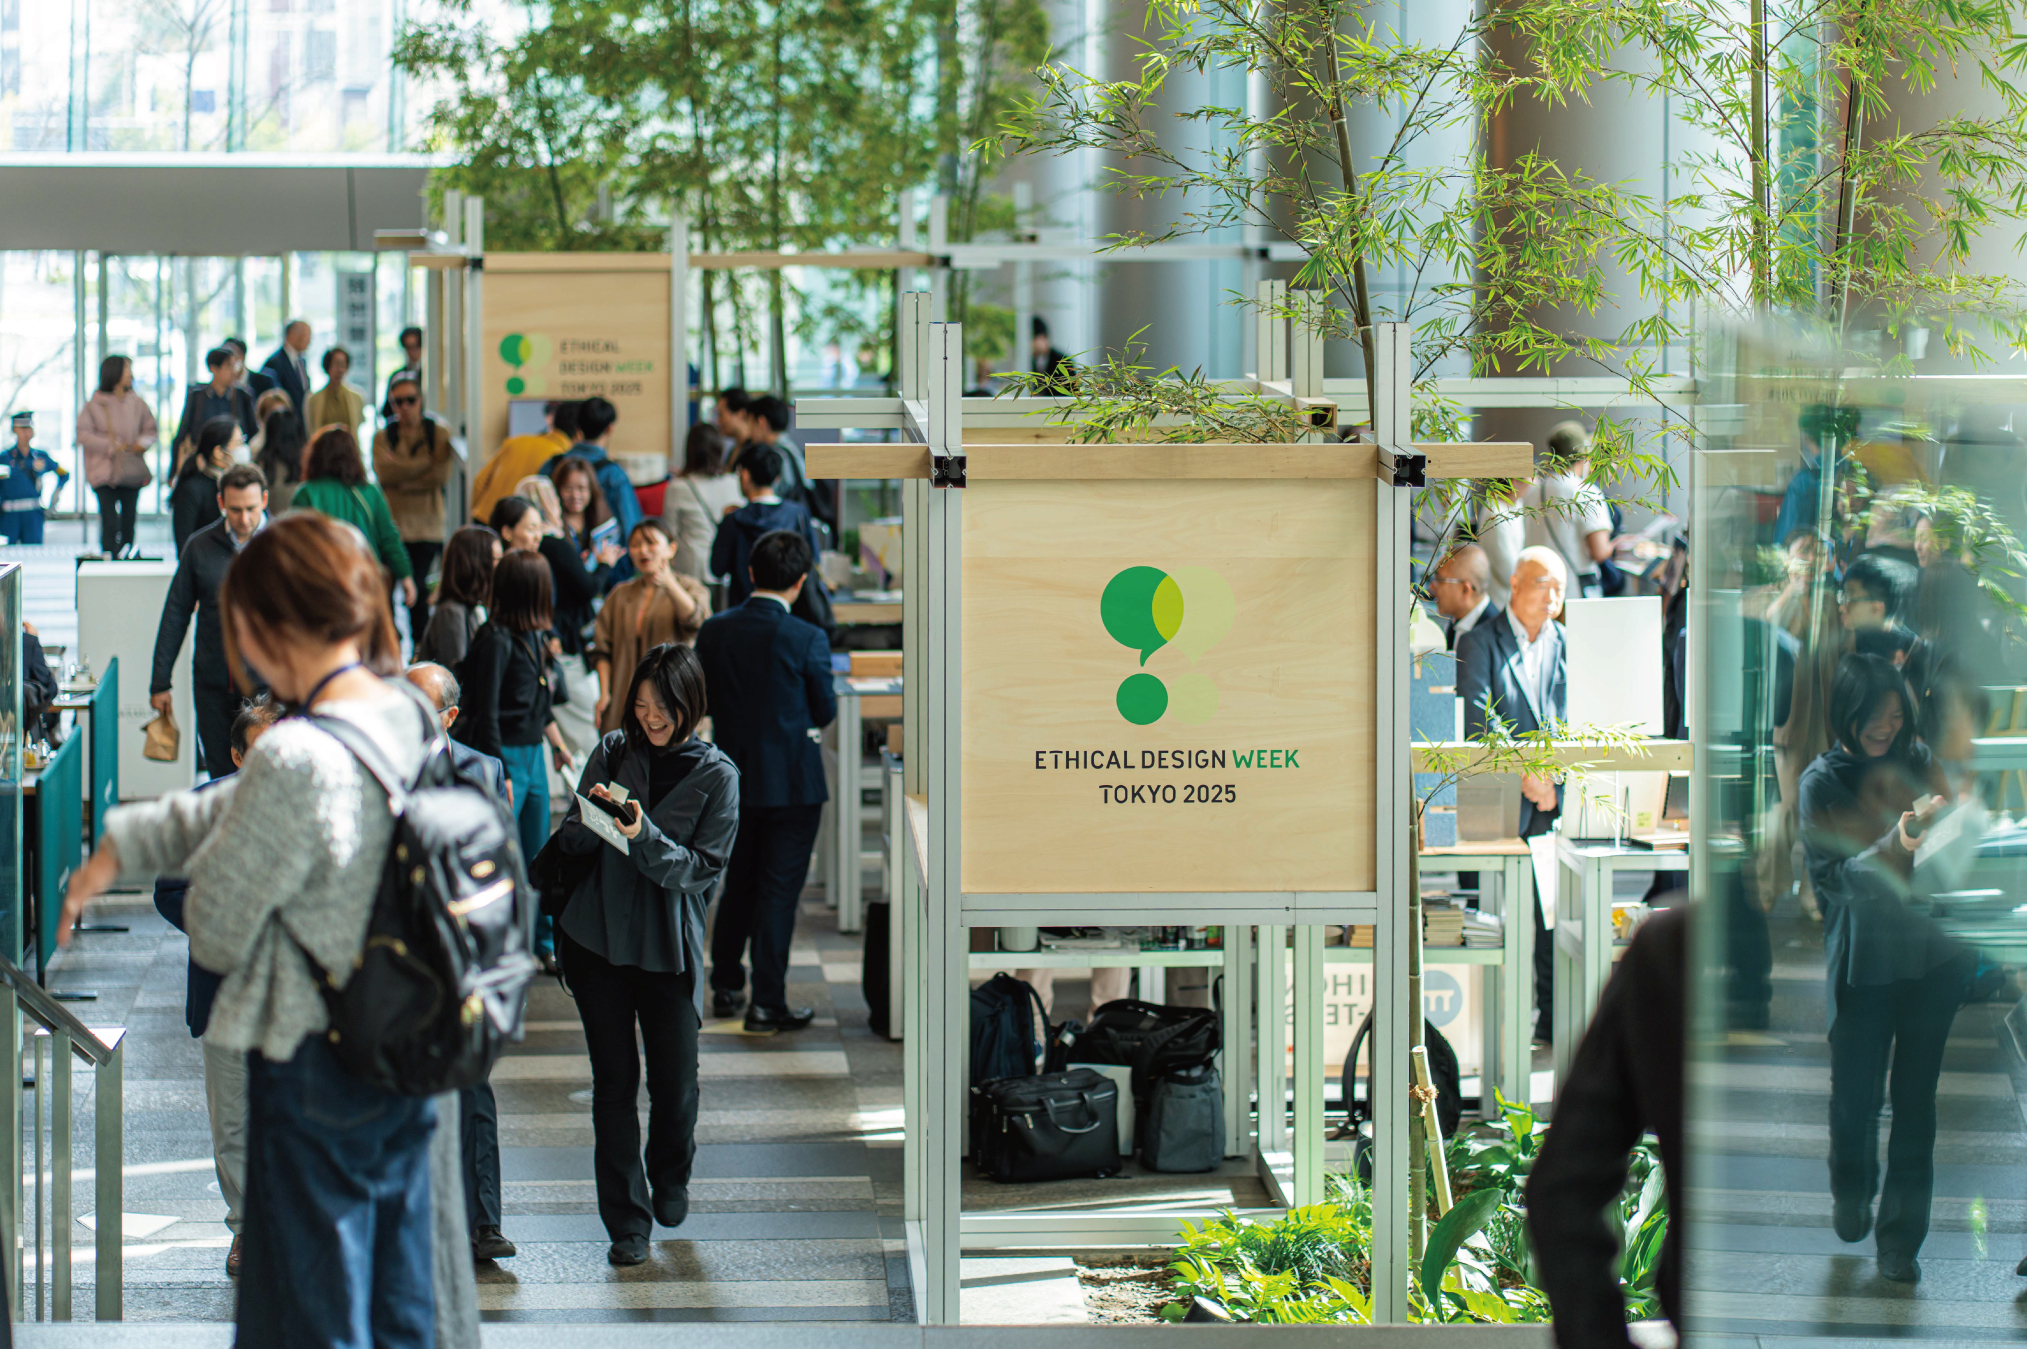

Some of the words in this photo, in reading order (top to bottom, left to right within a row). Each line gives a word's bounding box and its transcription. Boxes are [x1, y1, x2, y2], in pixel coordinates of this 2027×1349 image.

[560, 339, 619, 353] ETHICAL
[1035, 750, 1135, 769] ETHICAL
[1142, 750, 1226, 769] DESIGN
[1232, 750, 1300, 768] WEEK
[1099, 785, 1177, 804] TOKYO
[1184, 784, 1237, 803] 2025
